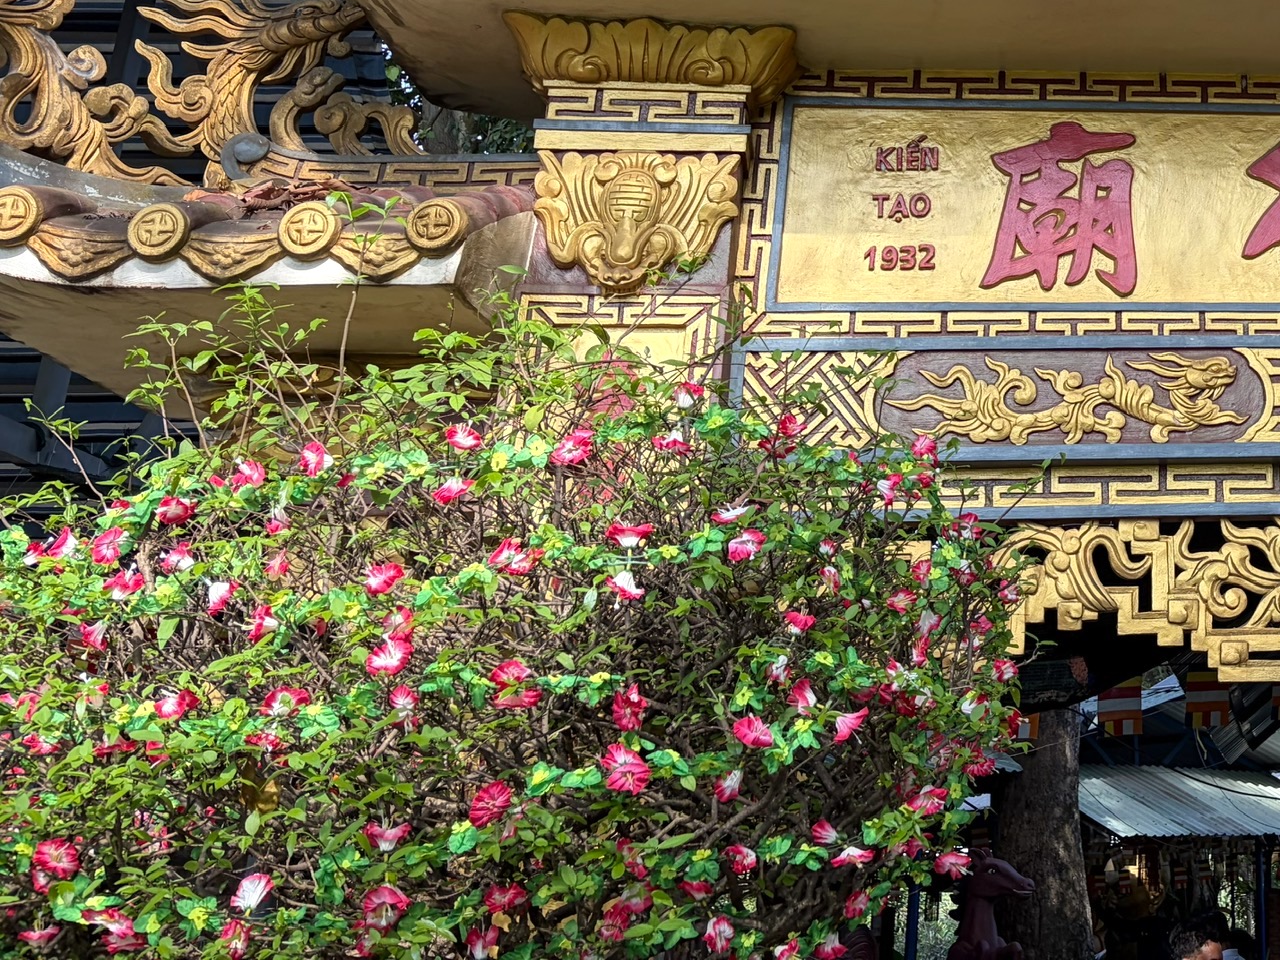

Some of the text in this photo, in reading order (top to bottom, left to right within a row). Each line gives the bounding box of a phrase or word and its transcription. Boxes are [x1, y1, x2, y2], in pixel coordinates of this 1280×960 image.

[875, 134, 939, 172] KIẾN
[872, 192, 931, 223] TẠO
[864, 244, 936, 271] 1932
